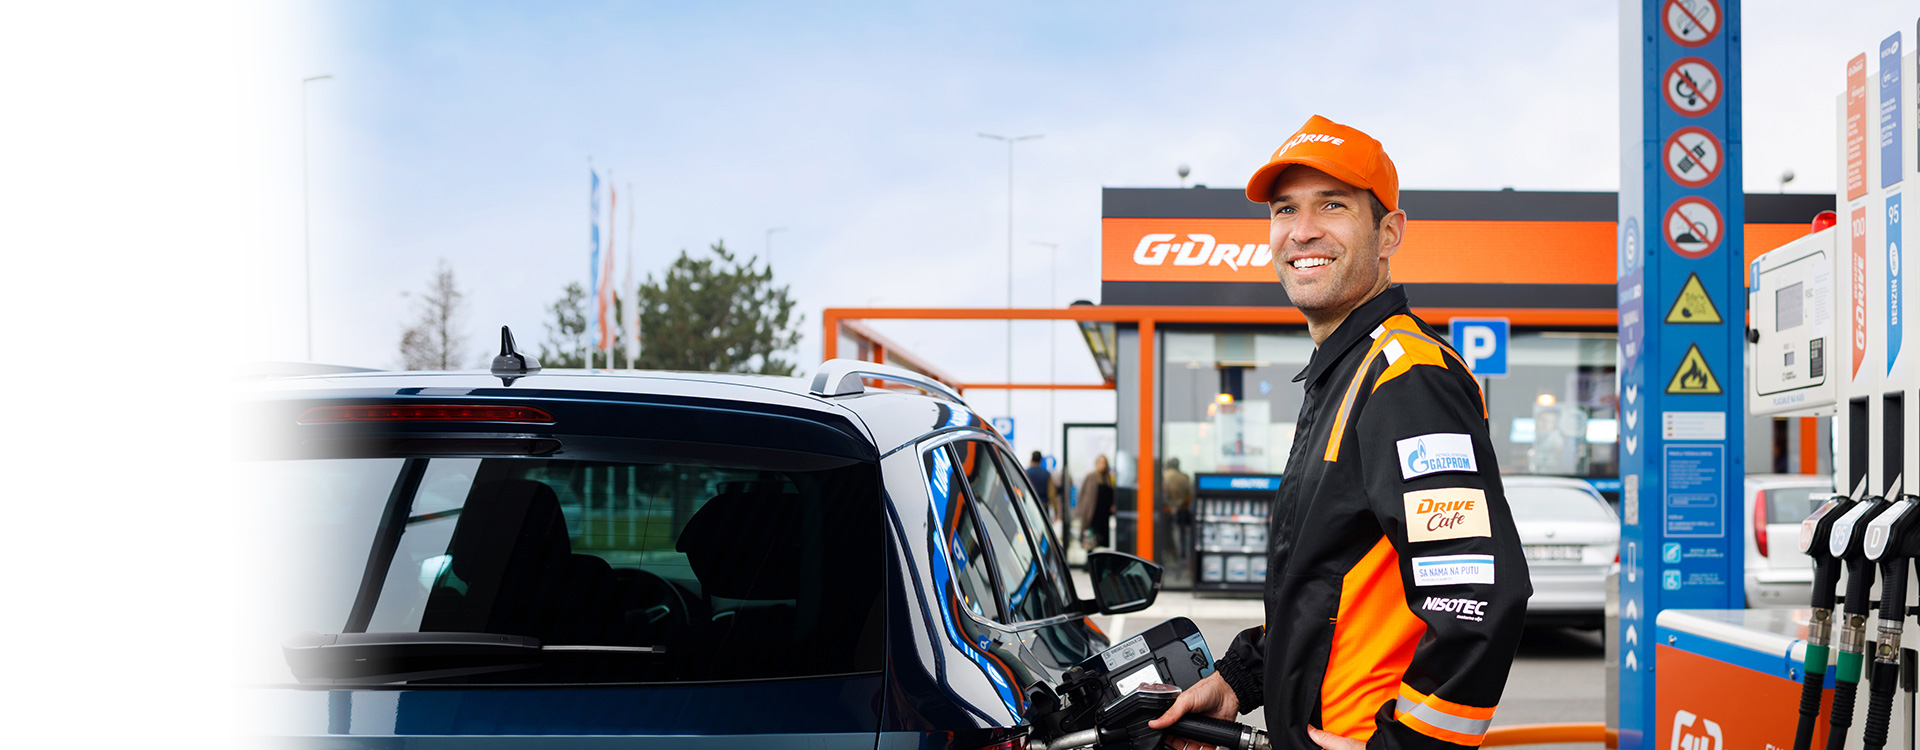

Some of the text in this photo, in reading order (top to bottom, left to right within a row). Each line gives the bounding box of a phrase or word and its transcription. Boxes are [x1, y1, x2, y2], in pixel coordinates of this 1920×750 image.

[1888, 204, 1899, 226] 95
[1853, 217, 1866, 239] 100
[1752, 265, 1758, 290] 1
[1463, 325, 1496, 370] P
[1429, 457, 1471, 471] GAZPROM
[1416, 498, 1476, 514] DRIVE
[1426, 512, 1466, 532] Cafe
[1871, 527, 1881, 548] D
[1419, 566, 1480, 577] SA NAMA NA PUTU
[1422, 596, 1489, 616] NISOTEC
